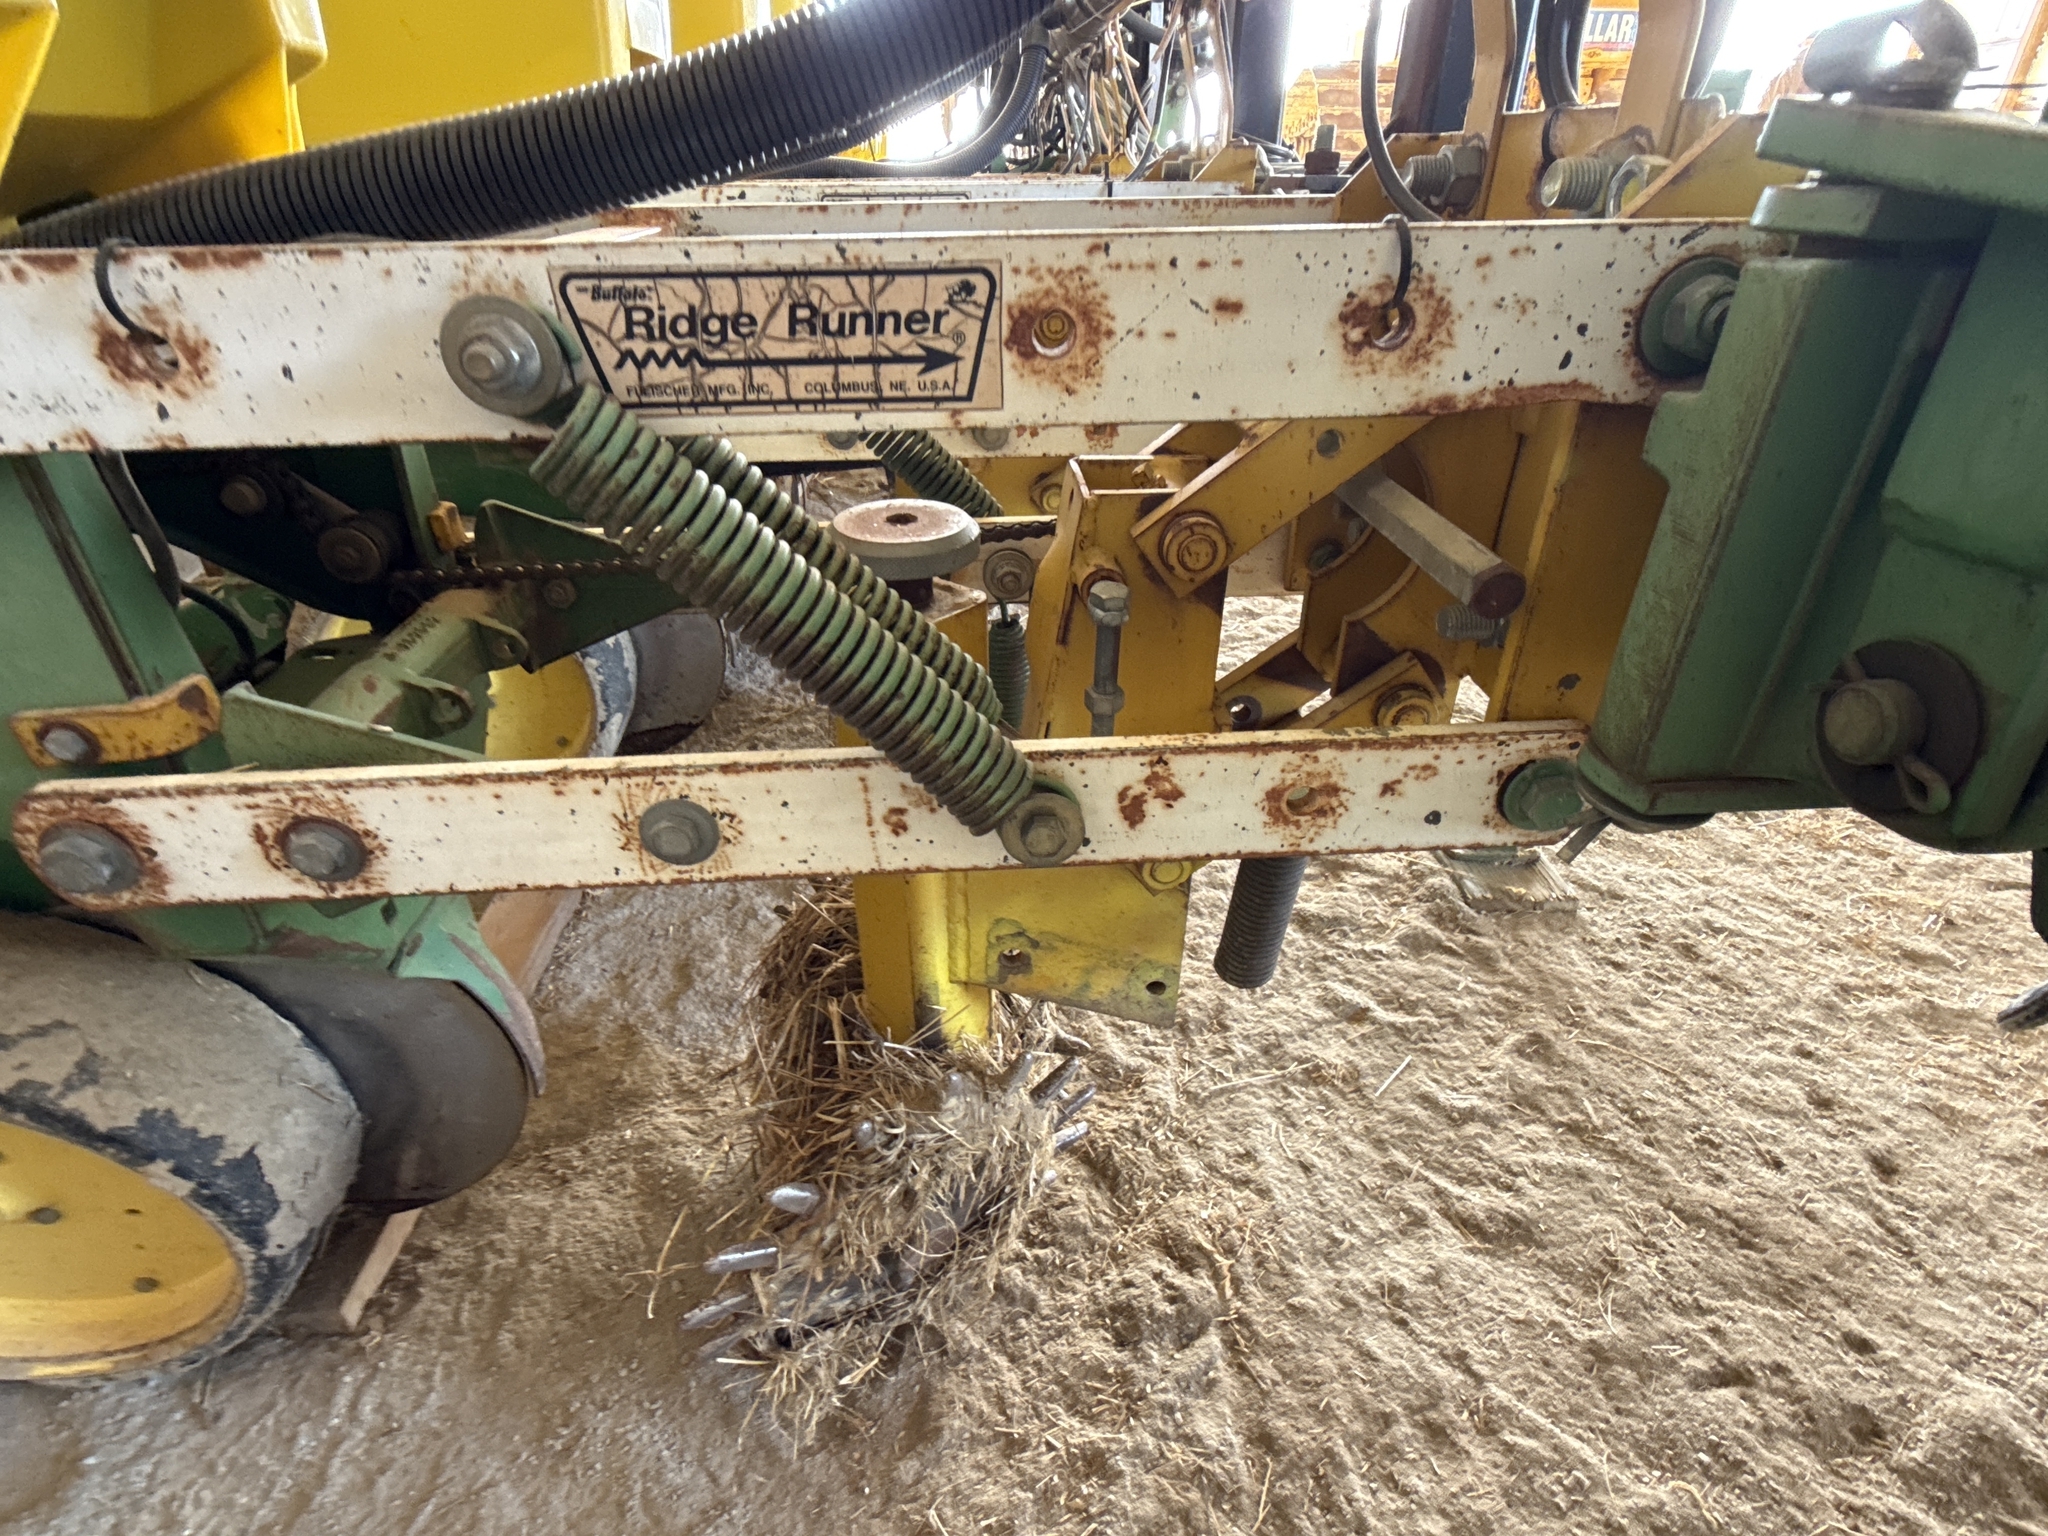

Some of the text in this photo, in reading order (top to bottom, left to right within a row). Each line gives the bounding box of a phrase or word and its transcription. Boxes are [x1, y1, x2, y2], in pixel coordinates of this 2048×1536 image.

[624, 302, 949, 346] Ridge Runner
[707, 383, 739, 397] MFG.
